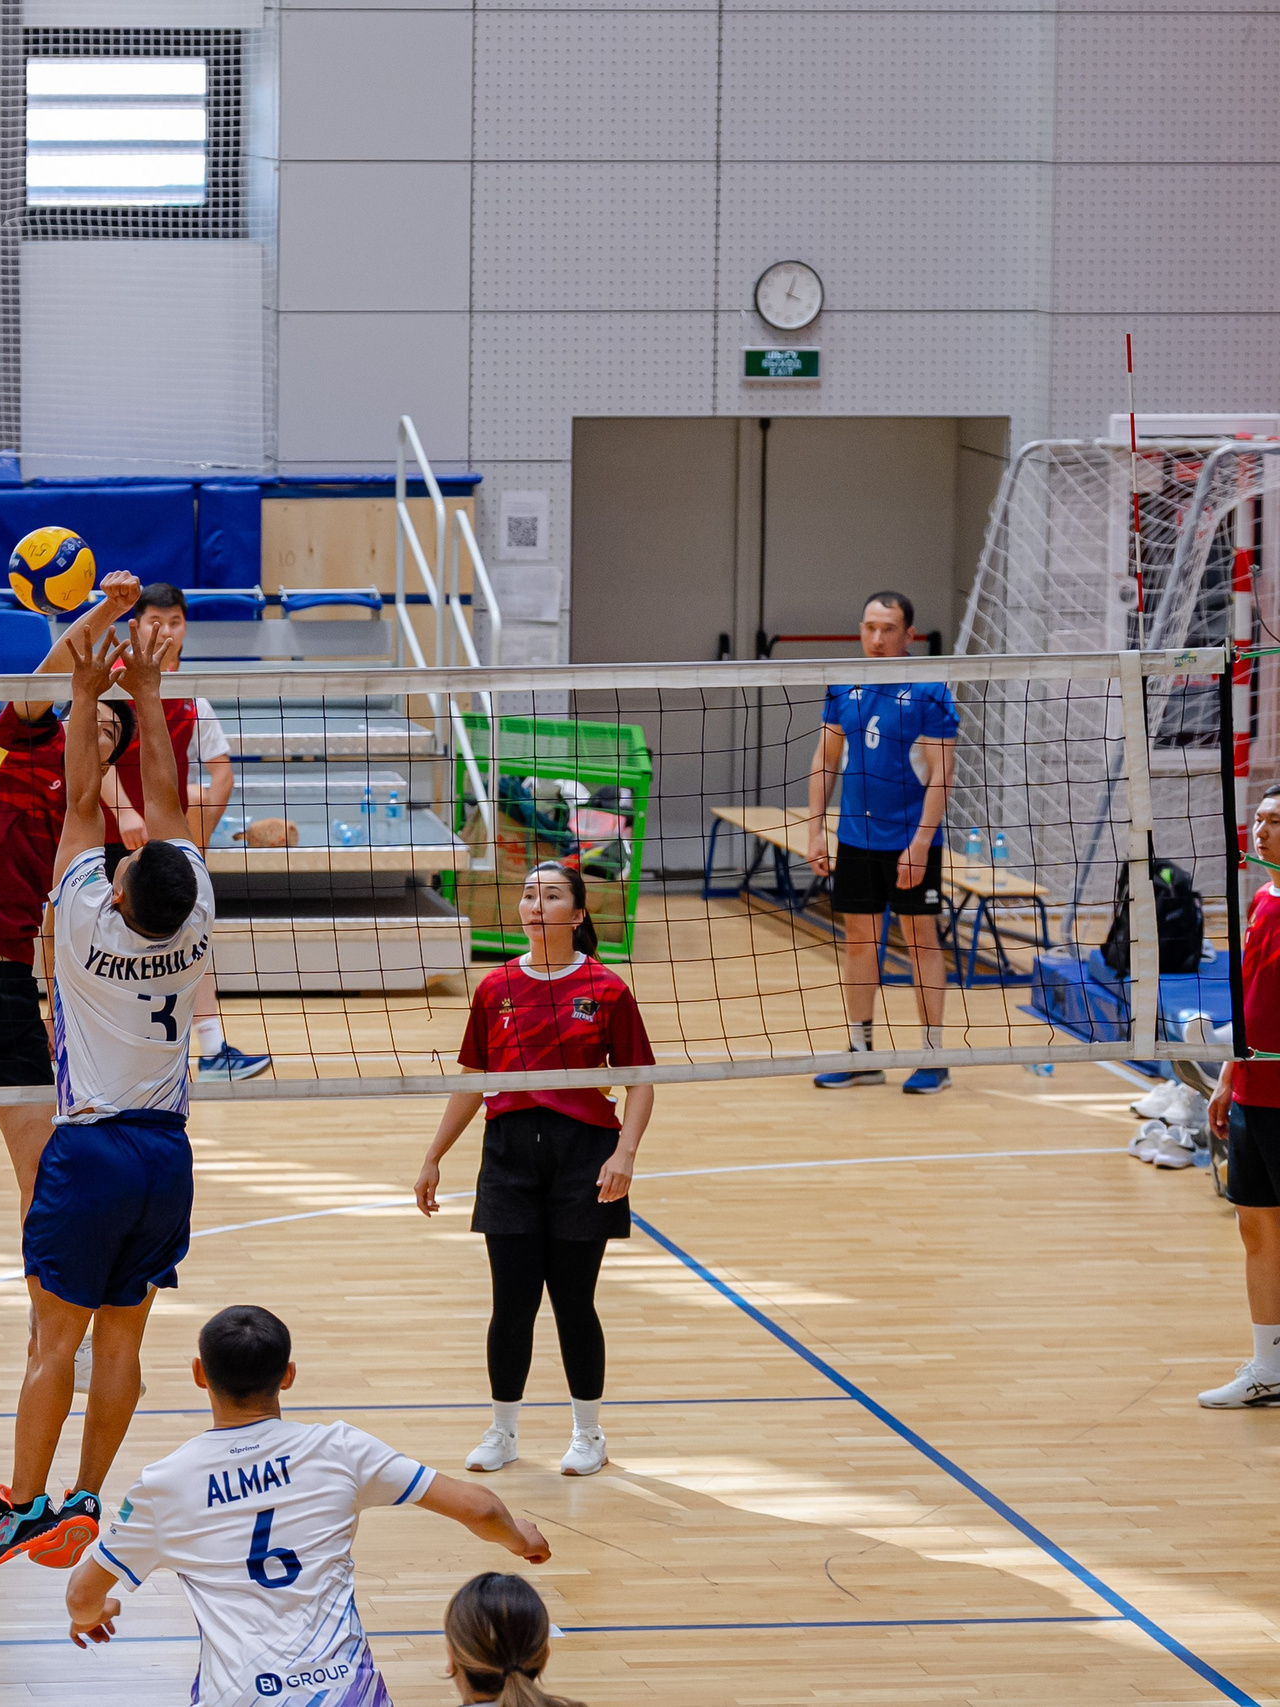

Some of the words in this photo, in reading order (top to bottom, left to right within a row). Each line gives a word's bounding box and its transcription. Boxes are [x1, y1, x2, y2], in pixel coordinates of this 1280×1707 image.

[864, 714, 881, 750] 6
[137, 993, 178, 1042] 3
[502, 1015, 510, 1029] 7
[229, 1444, 260, 1455] alprima
[207, 1455, 291, 1508] ALMAT
[246, 1507, 303, 1589] 6
[258, 1675, 280, 1694] BI
[286, 1664, 349, 1688] GROUP
